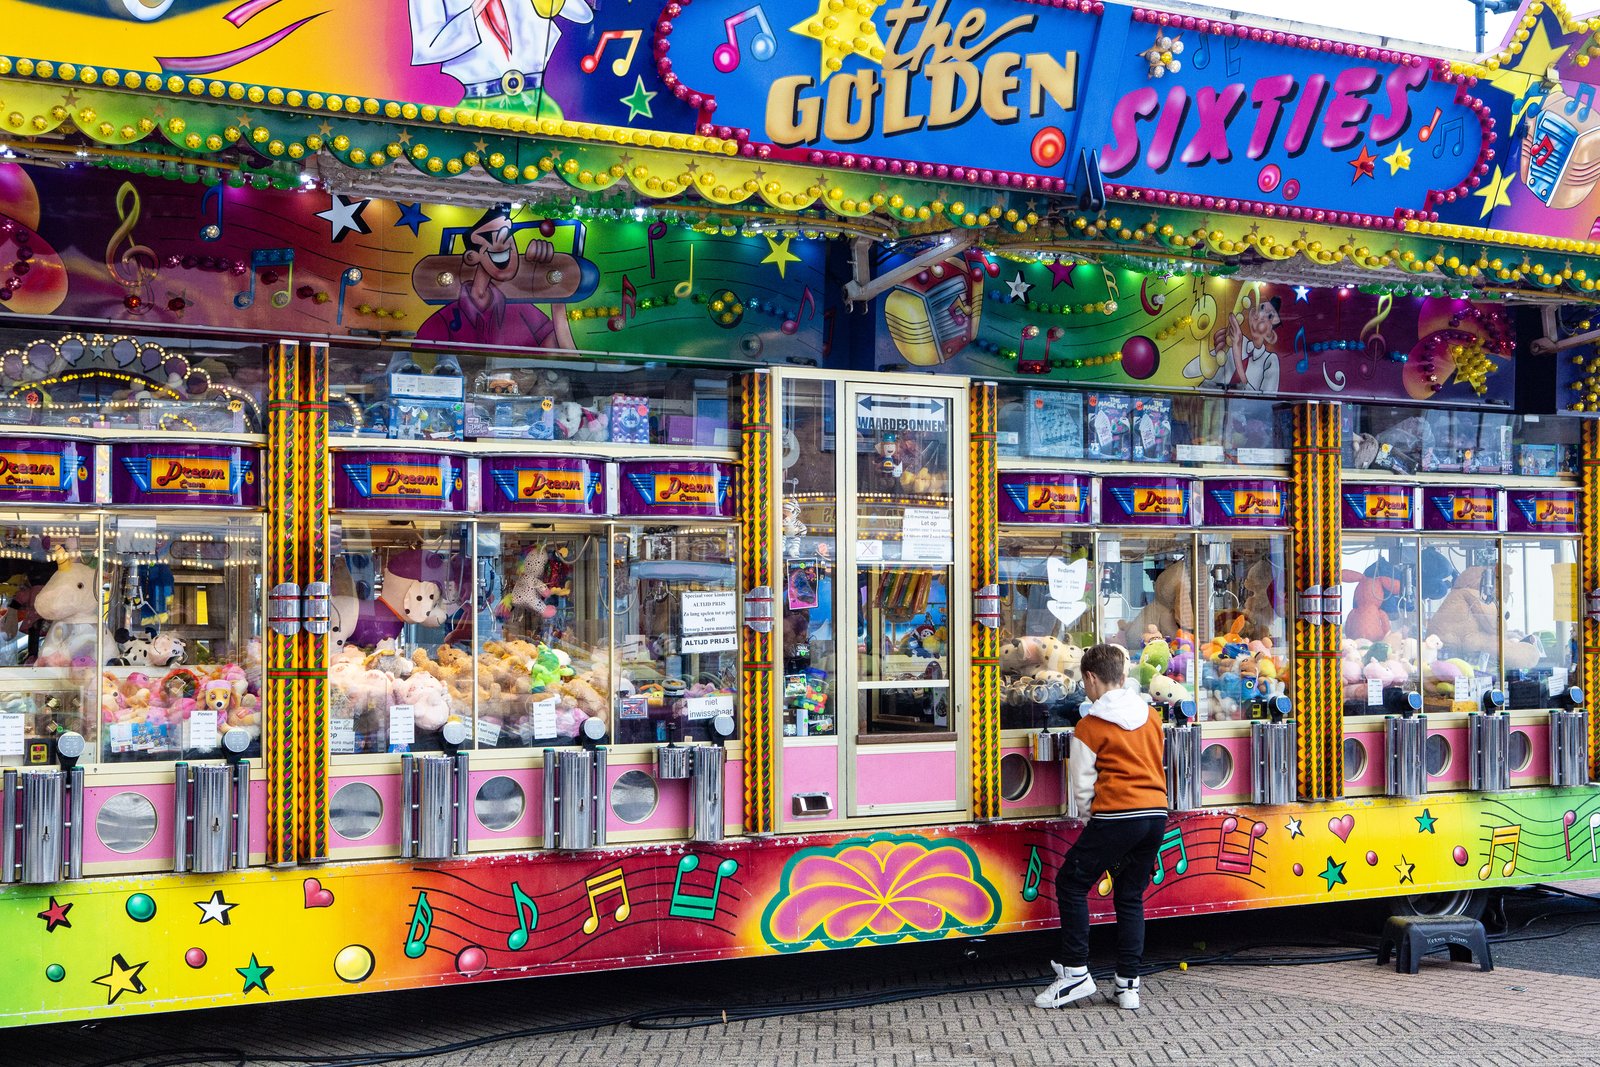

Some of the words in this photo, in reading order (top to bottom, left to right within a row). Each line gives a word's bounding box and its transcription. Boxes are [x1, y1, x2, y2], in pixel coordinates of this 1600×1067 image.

[882, 0, 1037, 71] the
[765, 50, 1078, 146] GOLDEN
[1098, 64, 1431, 175] SIXTIES
[857, 416, 945, 432] WAARDEBONNEN
[156, 460, 225, 486] Dream
[376, 467, 438, 492] Dream
[523, 472, 581, 497] Dream
[660, 476, 715, 498] Dream
[1033, 487, 1077, 508] Dream
[1138, 490, 1182, 511] Dream
[1239, 492, 1279, 513] Dream
[1370, 495, 1407, 515] Dream
[1457, 499, 1493, 518] Dream
[1539, 501, 1574, 519] Dream
